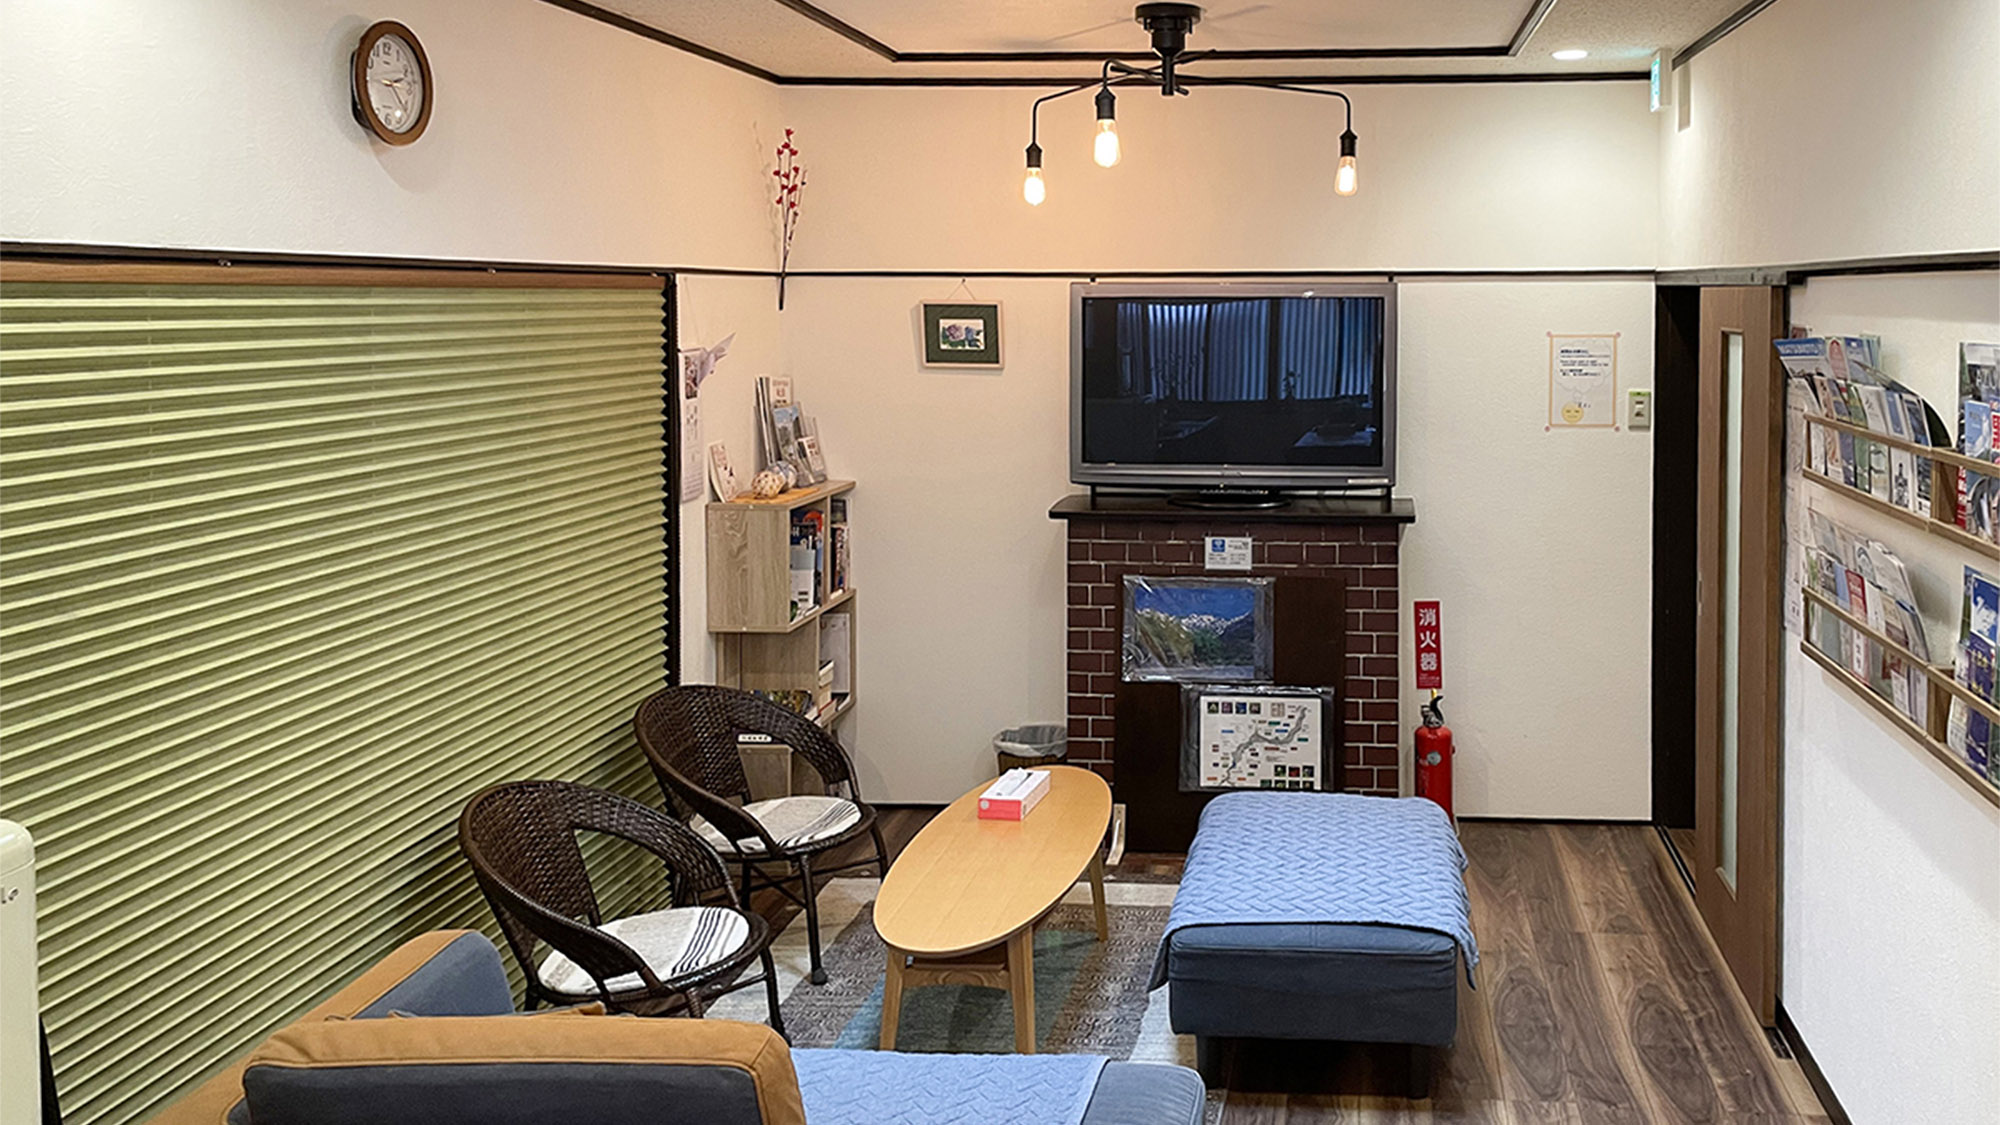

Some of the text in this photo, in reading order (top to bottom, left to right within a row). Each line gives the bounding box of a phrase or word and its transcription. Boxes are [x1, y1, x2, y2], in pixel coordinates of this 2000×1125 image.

[383, 42, 391, 56] 12
[385, 113, 392, 126] 6
[1418, 608, 1438, 671] 消火器
